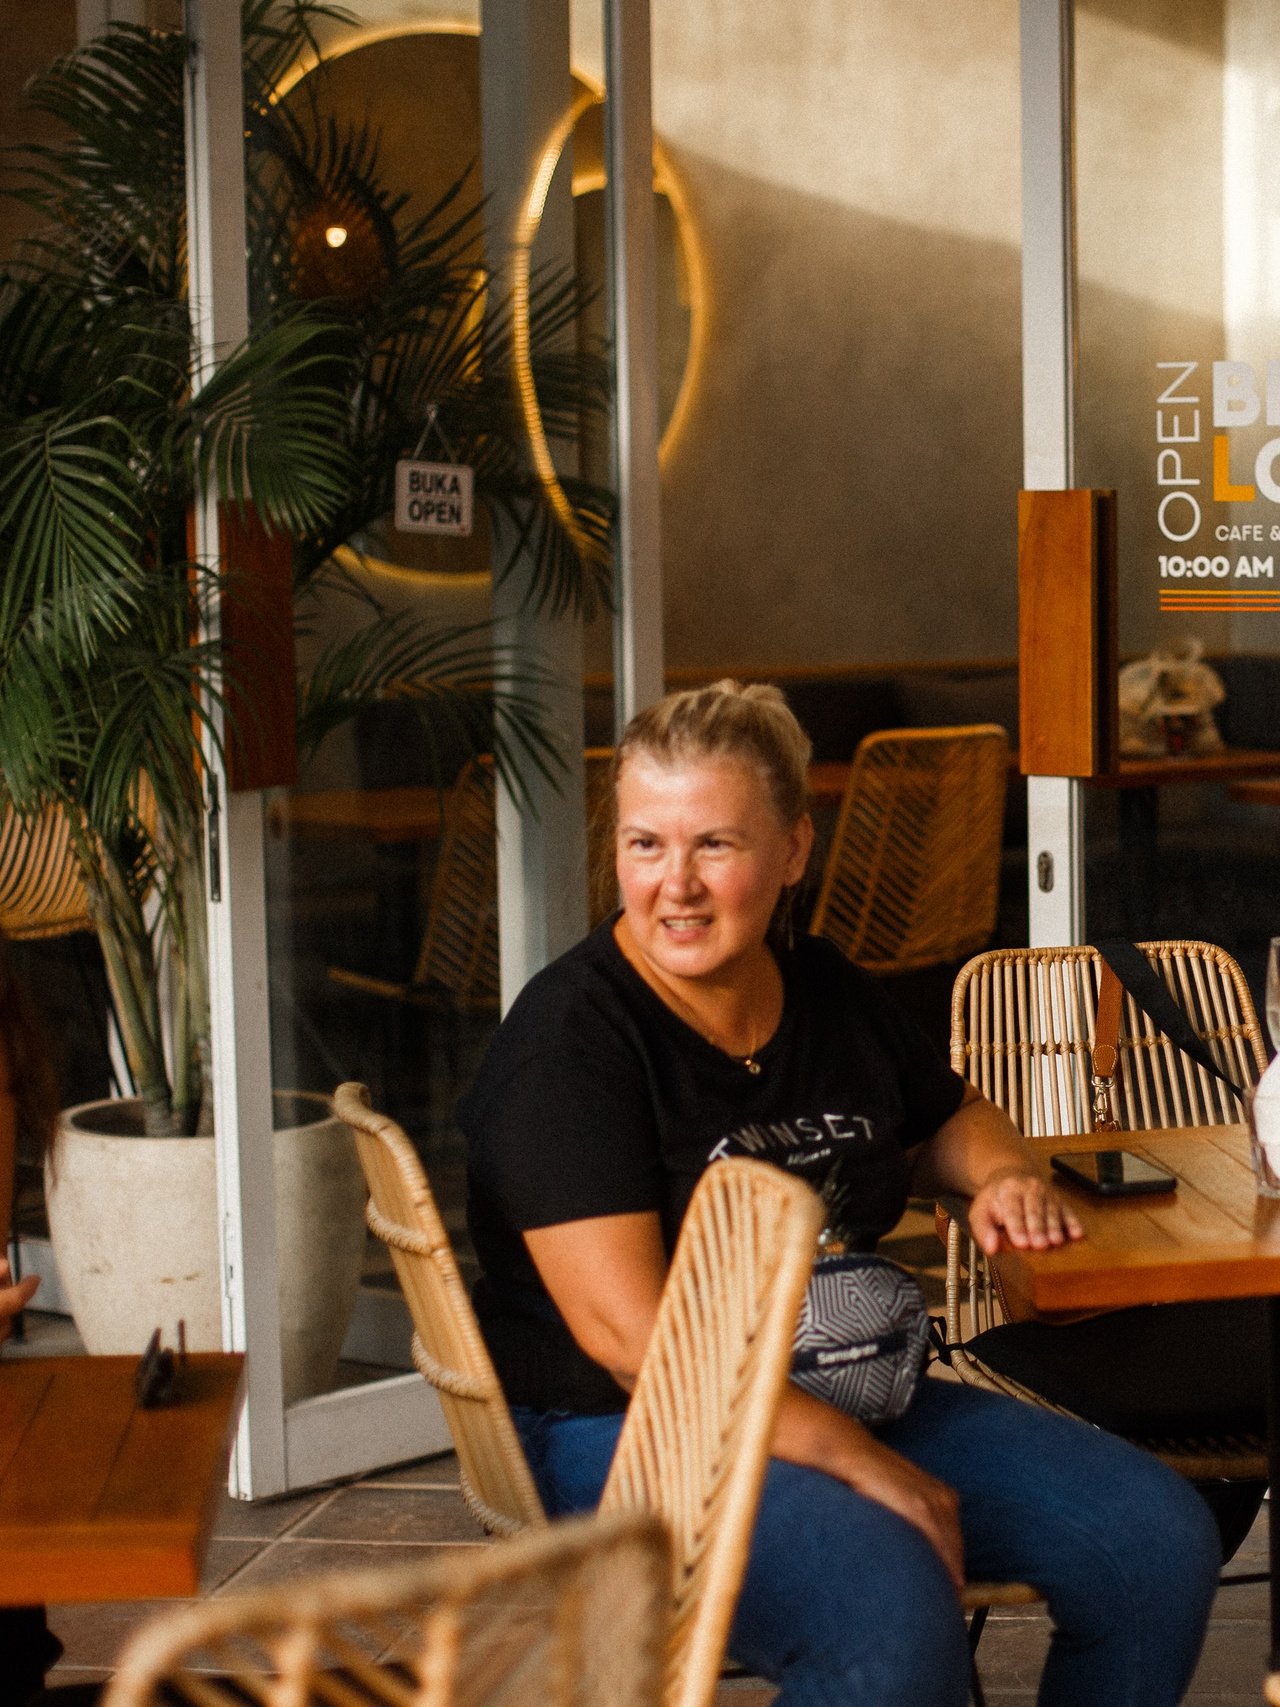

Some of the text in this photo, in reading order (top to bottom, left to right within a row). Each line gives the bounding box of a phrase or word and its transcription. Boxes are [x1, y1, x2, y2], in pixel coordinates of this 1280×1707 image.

[1156, 361, 1201, 543] OPEN
[408, 471, 461, 495] BUKA
[408, 498, 462, 524] OPEN
[1215, 524, 1264, 542] CAFE
[1158, 555, 1230, 578] 10:00
[1234, 556, 1274, 578] AM
